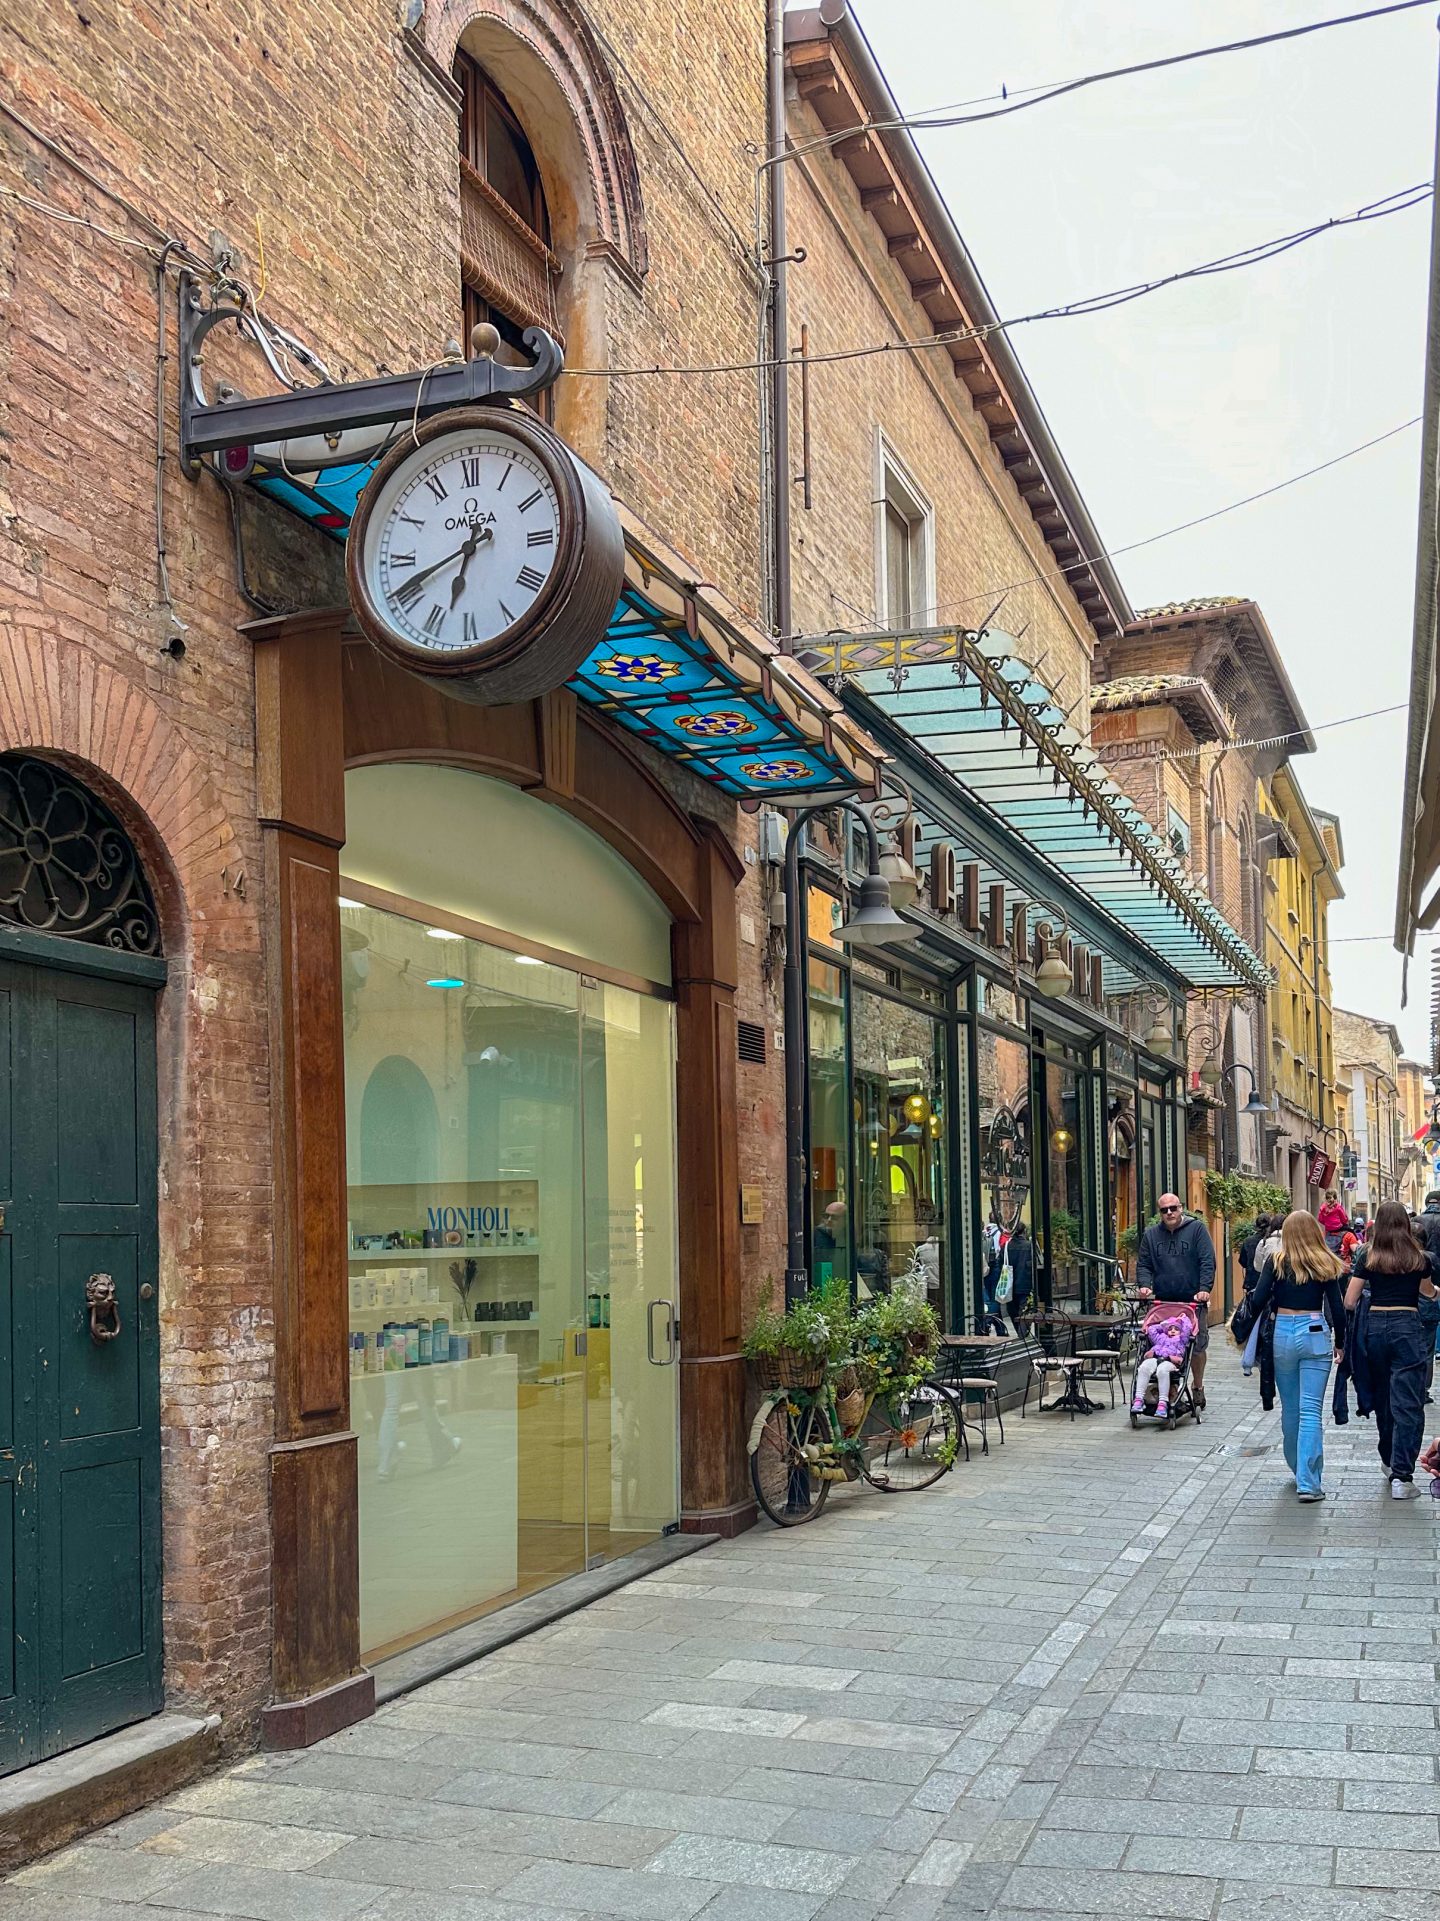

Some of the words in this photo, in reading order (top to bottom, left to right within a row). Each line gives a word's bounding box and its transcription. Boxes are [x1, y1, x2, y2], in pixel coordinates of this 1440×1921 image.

[461, 457, 480, 489] XII
[424, 473, 449, 505] XI
[517, 488, 544, 514] II
[398, 510, 425, 533] X
[444, 511, 497, 531] OMEGA
[527, 529, 553, 548] III
[395, 583, 425, 614] VII
[220, 866, 247, 898] 14
[427, 1206, 509, 1231] MONHOLI
